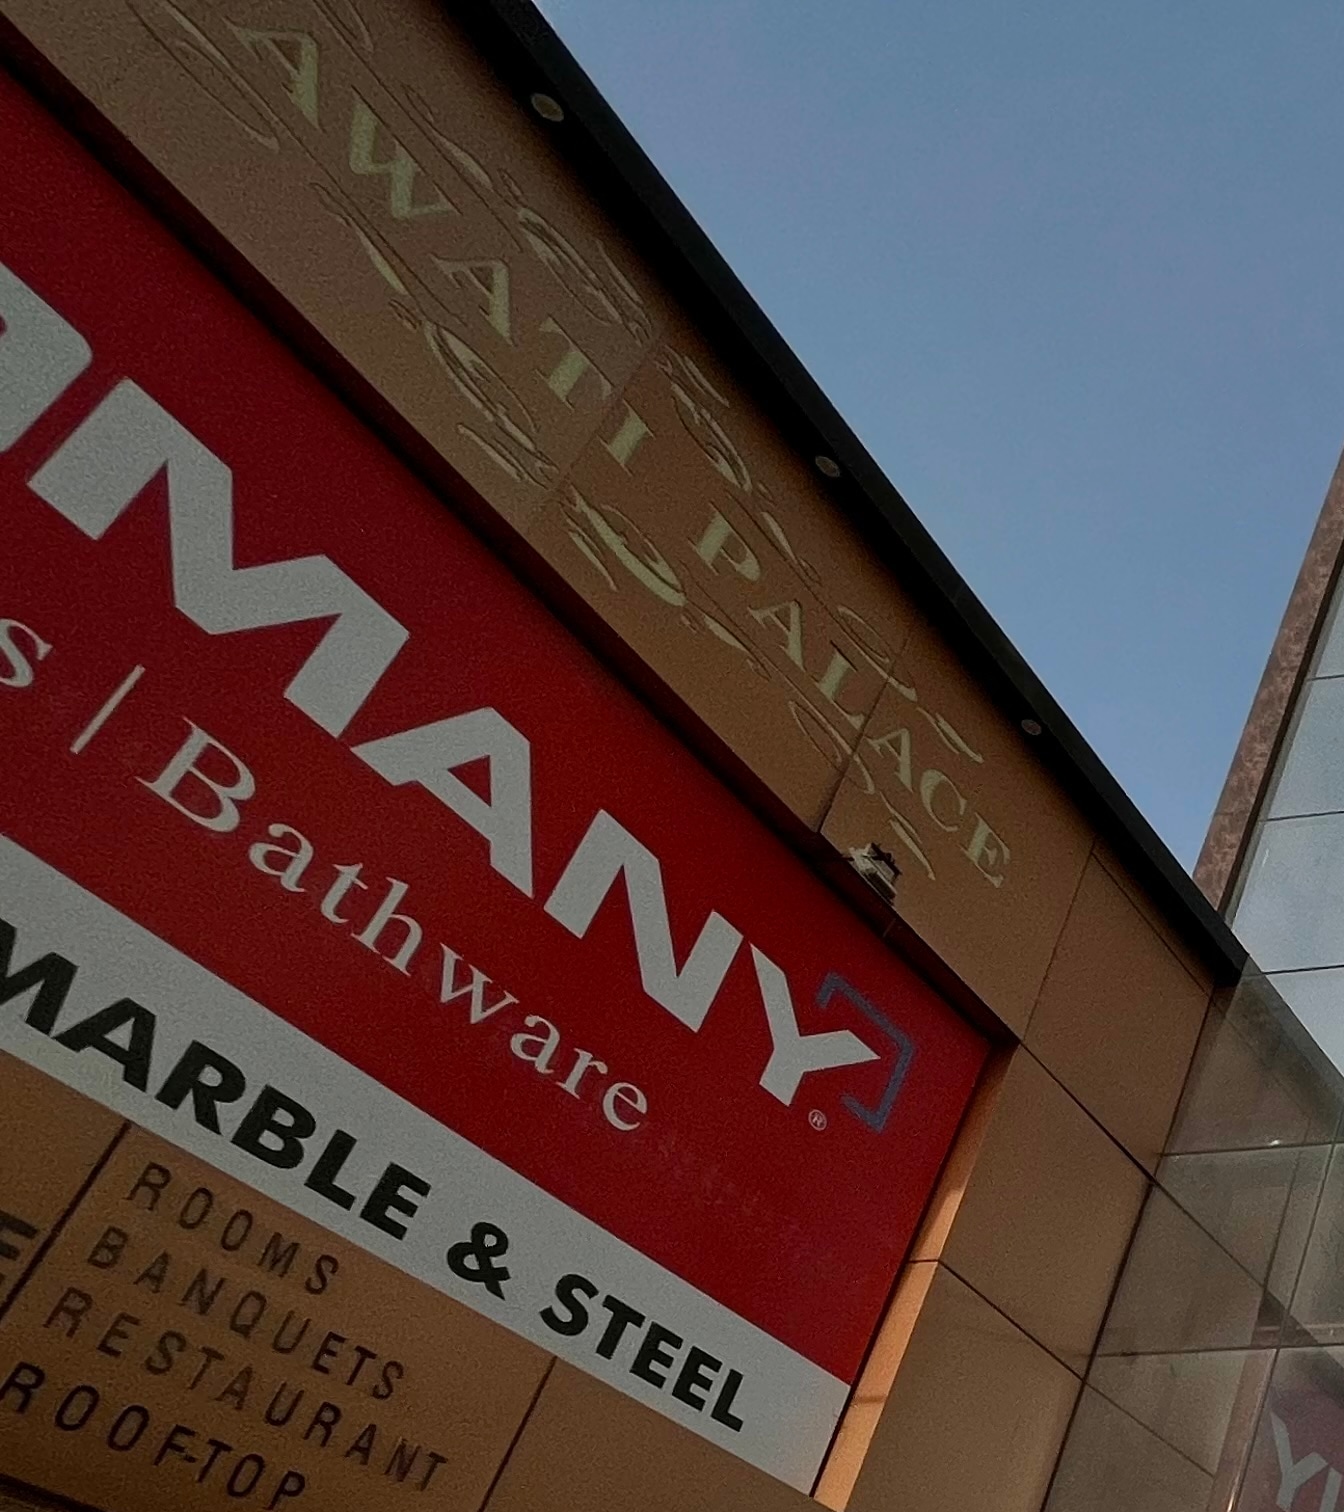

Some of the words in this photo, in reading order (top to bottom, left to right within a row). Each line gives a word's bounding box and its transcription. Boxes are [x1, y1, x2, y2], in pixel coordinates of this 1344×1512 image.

[688, 502, 1011, 888] PALACE
[136, 718, 649, 1131] Bathware
[87, 1227, 405, 1401] BANQUETS
[127, 1162, 339, 1295] ROOMS
[447, 1222, 509, 1300] &
[539, 1273, 746, 1432] STEEL
[43, 1287, 449, 1492] RESTAURANT
